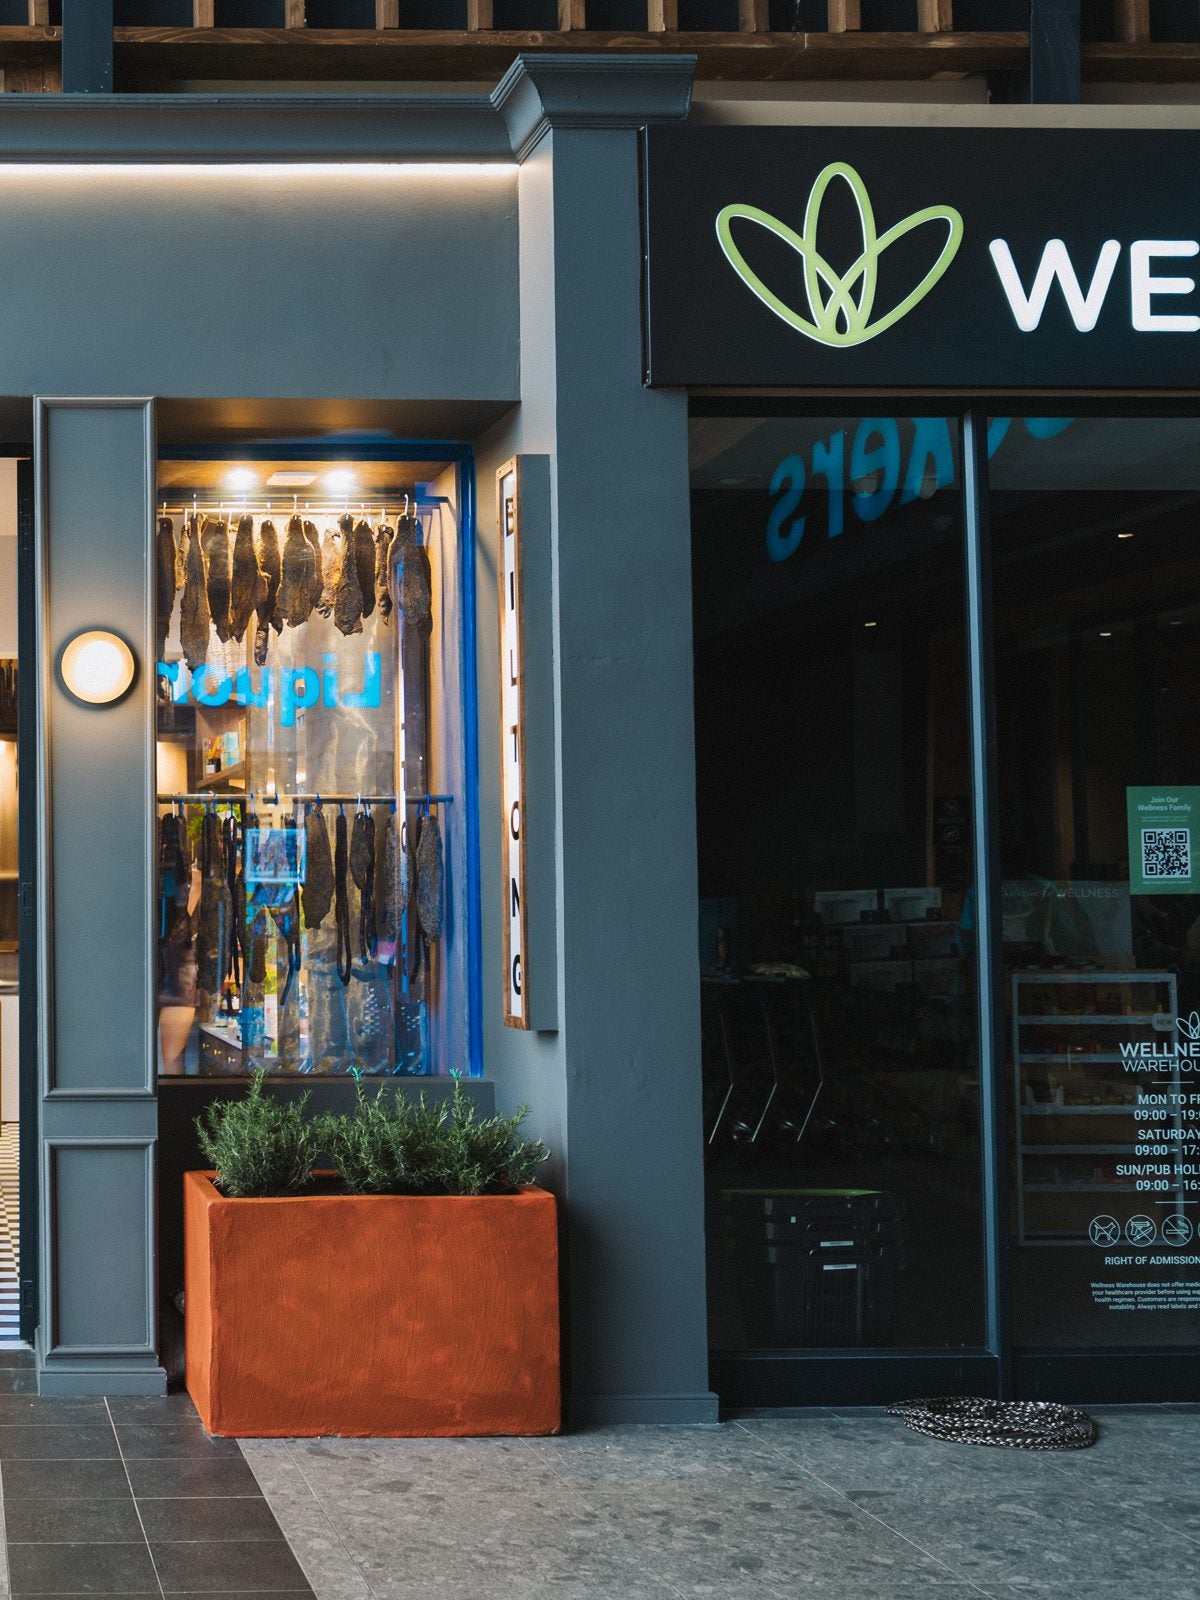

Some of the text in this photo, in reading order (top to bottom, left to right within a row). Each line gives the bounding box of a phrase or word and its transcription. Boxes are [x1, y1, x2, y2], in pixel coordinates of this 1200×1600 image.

[989, 238, 1200, 332] WE
[1169, 804, 1192, 812] Family
[1119, 1042, 1200, 1058] WELLNE
[1137, 1094, 1167, 1105] MON
[1170, 1094, 1187, 1105] TO
[1134, 1109, 1167, 1121] 09:00
[1135, 1144, 1168, 1156] 09:00
[1116, 1164, 1171, 1175] SUN/PUB
[1136, 1179, 1169, 1191] 09:00
[1104, 1255, 1200, 1265] RIGHT OF ADMISSION
[1157, 1288, 1175, 1296] before
[1176, 1288, 1191, 1296] using
[1137, 1303, 1157, 1311] Always
